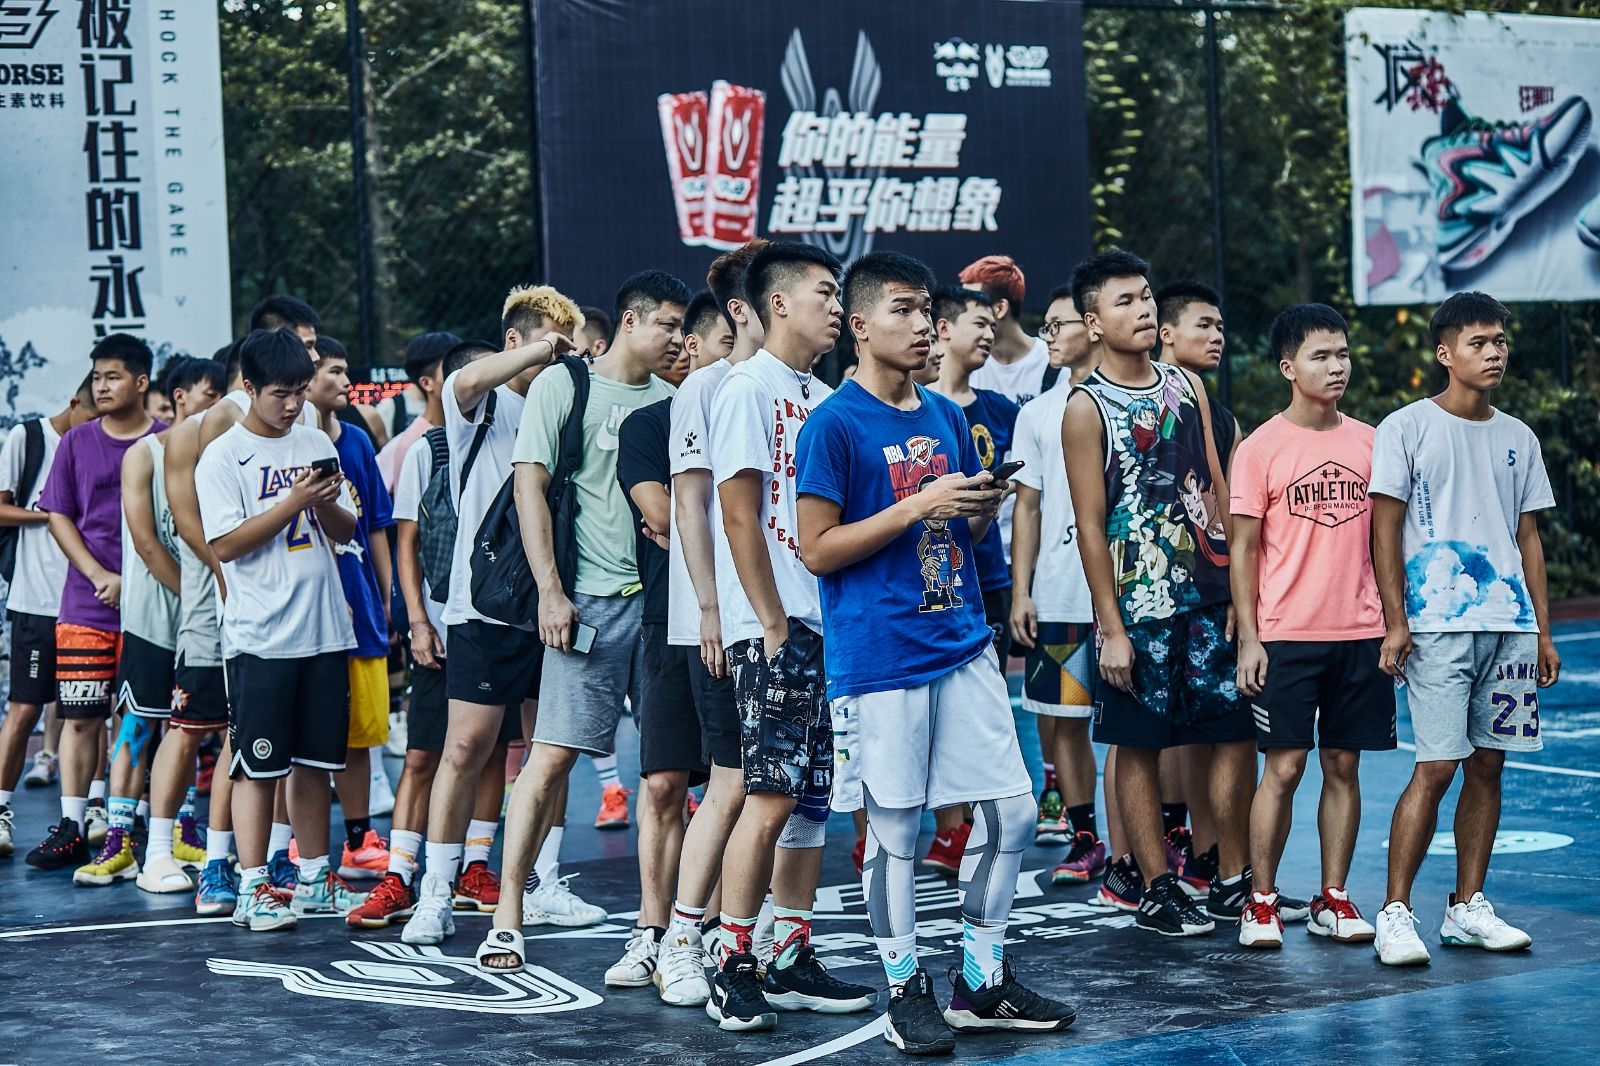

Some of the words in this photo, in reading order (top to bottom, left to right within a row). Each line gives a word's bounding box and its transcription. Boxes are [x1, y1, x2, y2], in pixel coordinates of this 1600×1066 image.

[164, 108, 183, 158] THE
[778, 111, 968, 168] 你的能量
[167, 182, 187, 257] GAME
[768, 176, 1002, 233] 超乎你想象
[883, 444, 905, 465] NBA
[1507, 449, 1516, 466] 5
[1294, 480, 1366, 506] ATHLETICS
[1304, 502, 1360, 512] PERFORMANCE
[1491, 691, 1540, 738] 23
